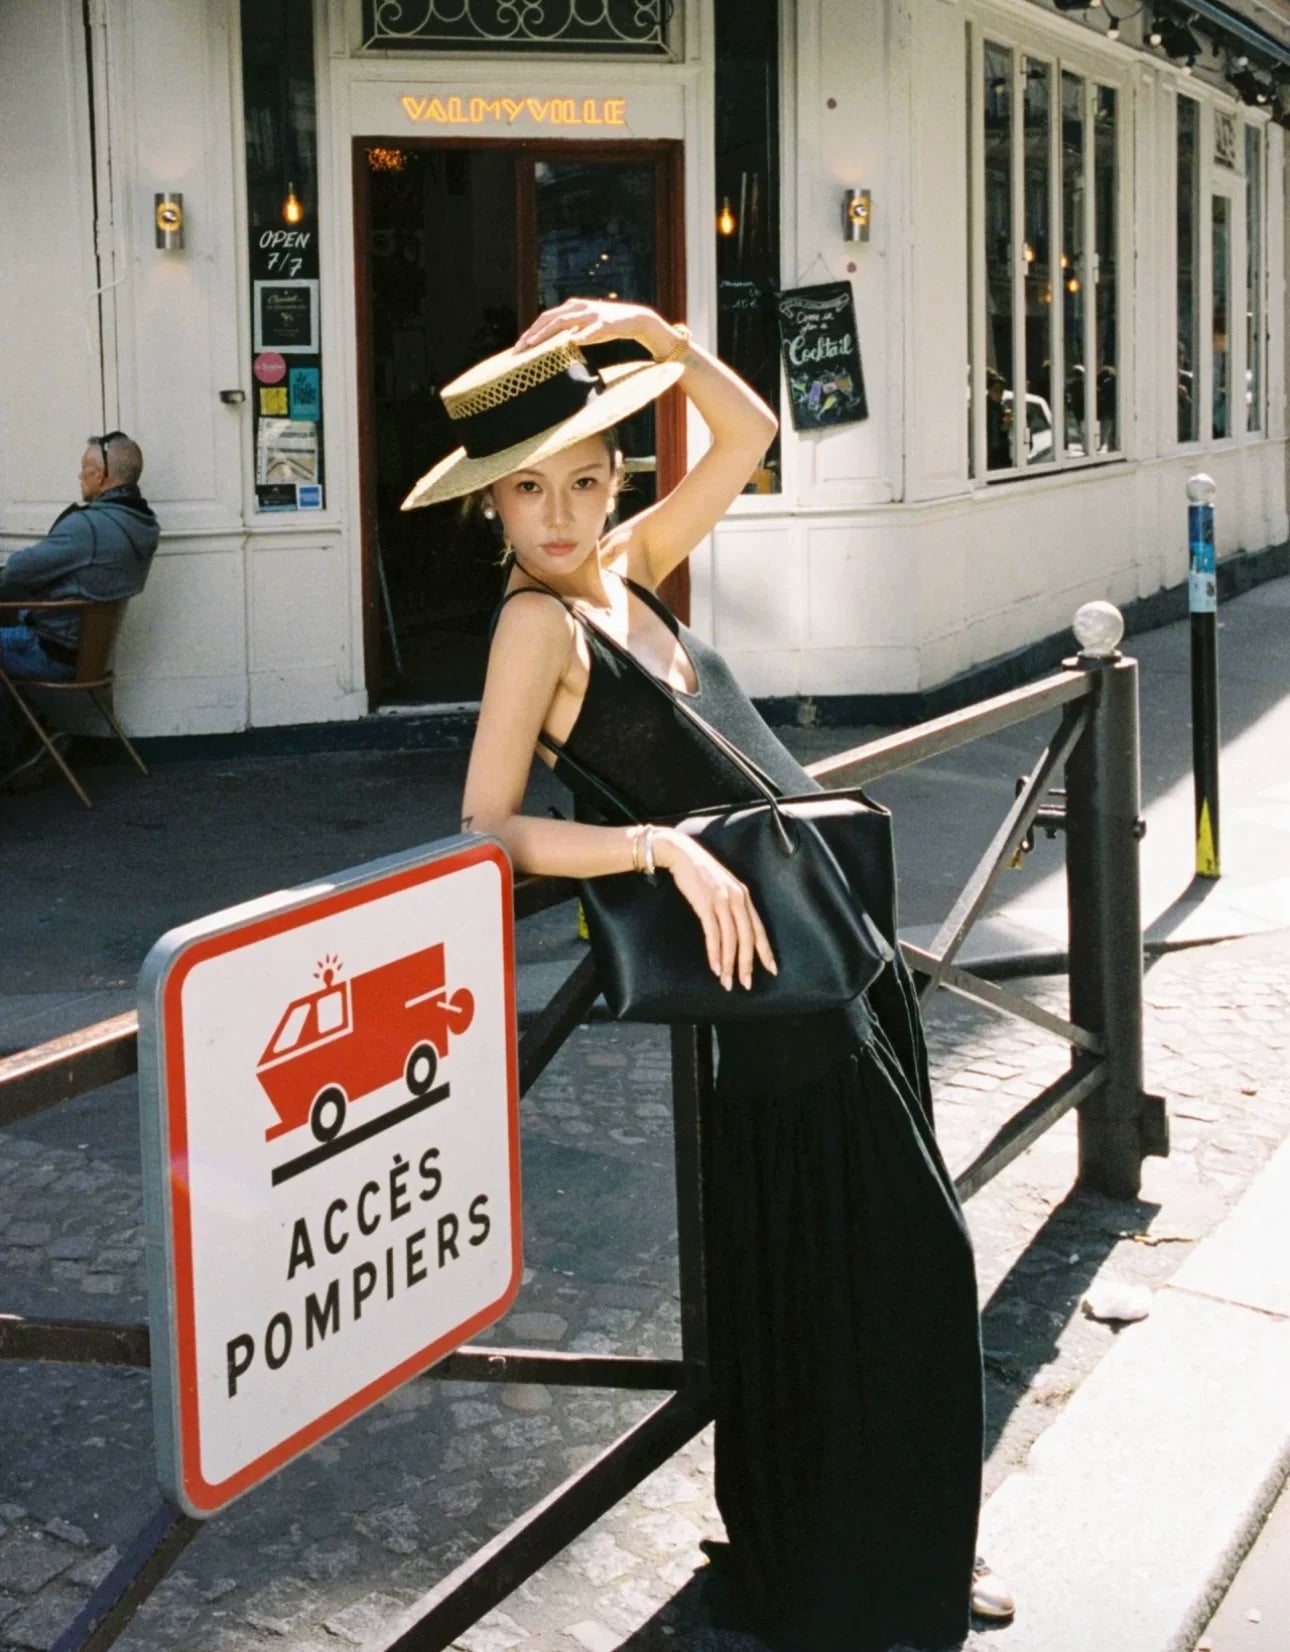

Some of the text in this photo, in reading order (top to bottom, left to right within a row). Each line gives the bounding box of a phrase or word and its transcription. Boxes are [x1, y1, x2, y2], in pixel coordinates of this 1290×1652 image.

[401, 96, 627, 126] VALMYVILLE
[259, 229, 311, 249] OPEN
[267, 251, 303, 277] 7/7
[784, 333, 853, 366] Cocktail
[287, 1147, 442, 1281] ACCÈS
[226, 1194, 491, 1399] POMPIERS
